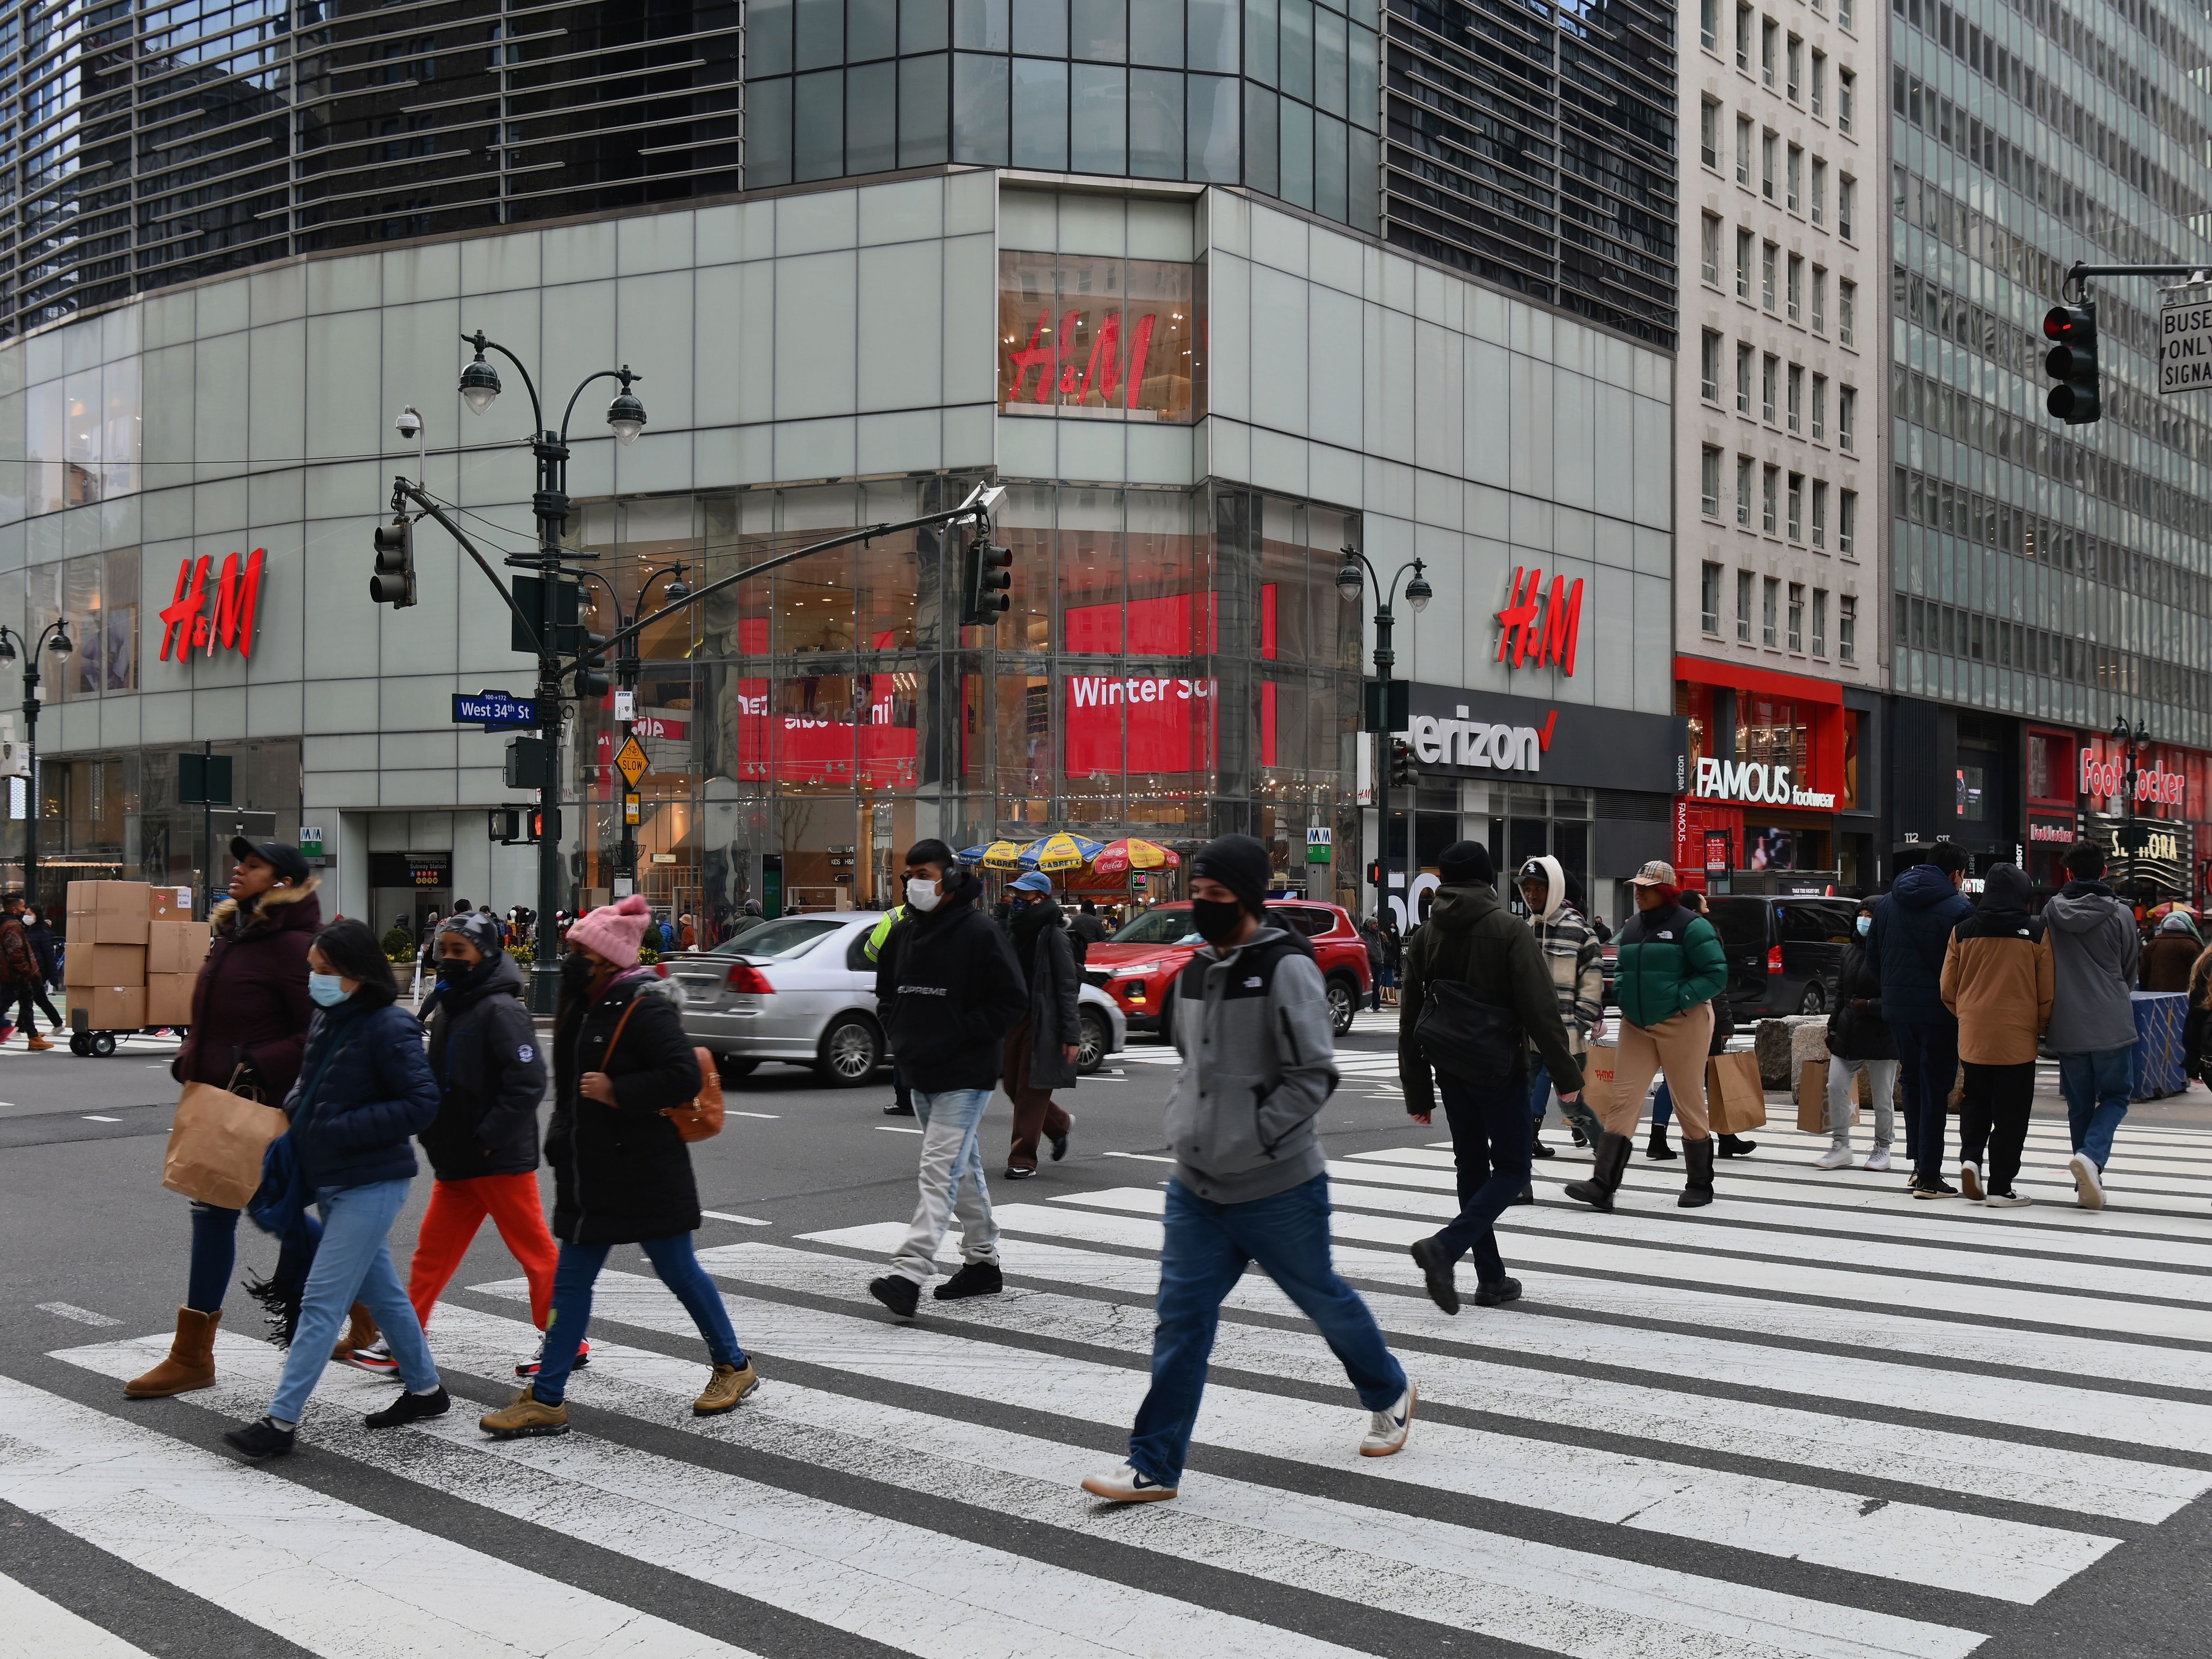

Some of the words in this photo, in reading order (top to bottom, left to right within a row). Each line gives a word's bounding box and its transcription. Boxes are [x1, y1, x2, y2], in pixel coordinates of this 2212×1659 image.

[1008, 308, 1156, 410] H&M
[159, 547, 268, 664] H&M
[1493, 566, 1584, 678] H&M
[1072, 676, 1170, 708] Winter
[461, 702, 491, 717] West
[494, 704, 515, 718] 34th
[518, 705, 530, 719] St
[623, 760, 642, 771] SLOW
[1676, 755, 1684, 791] verizon
[2080, 748, 2122, 797] Foot
[1358, 789, 1371, 800] H&M
[1696, 757, 1790, 804] FAMOUS
[1792, 785, 1836, 808] footwear
[1678, 802, 1686, 842] FAMOUS
[2030, 824, 2049, 841] Foot
[2048, 825, 2073, 843] Locker
[1905, 832, 1919, 843] 112
[2112, 831, 2178, 860] SORA
[1041, 858, 1080, 870] SABRETT
[1133, 874, 1146, 883] GYRO
[897, 985, 947, 996] SUPREME
